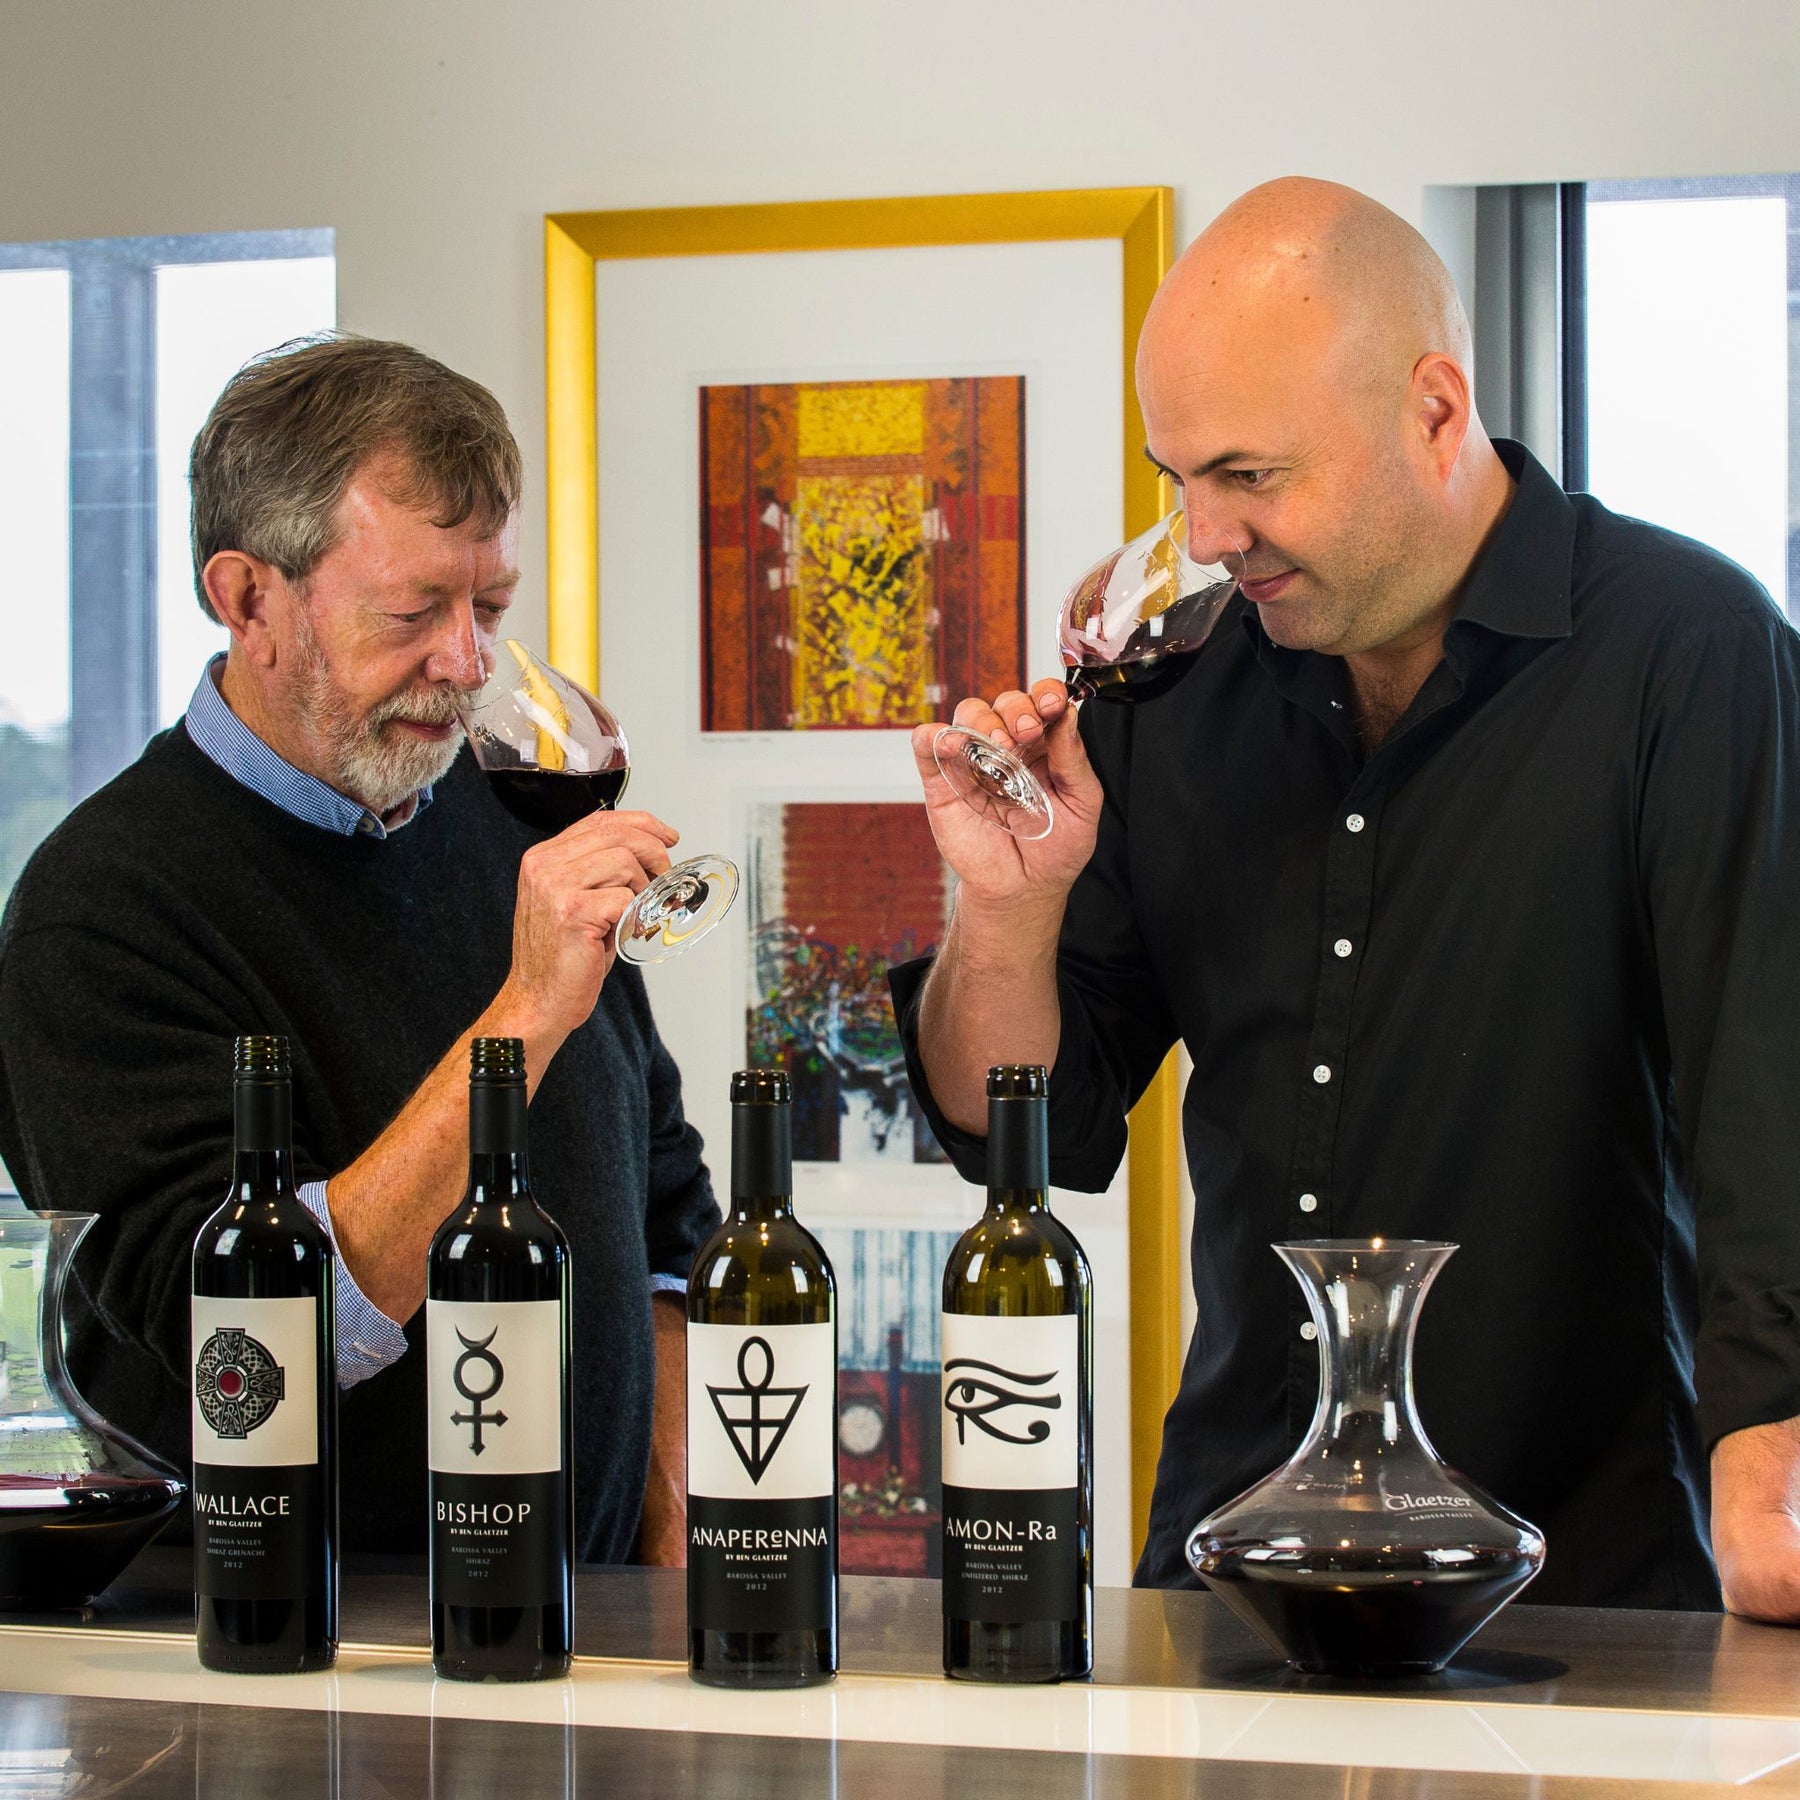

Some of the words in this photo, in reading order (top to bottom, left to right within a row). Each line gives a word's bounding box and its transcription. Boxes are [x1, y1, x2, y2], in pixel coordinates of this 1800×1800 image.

[195, 1492, 290, 1516] WALLACE
[1385, 1494, 1471, 1511] Glaetzer
[437, 1501, 531, 1524] BISHOP
[1409, 1514, 1444, 1522] BAROSSA
[215, 1519, 227, 1527] BEN
[228, 1520, 263, 1528] GLAETZER
[459, 1528, 472, 1536] BEN
[945, 1517, 1057, 1541] AMON-Ra
[208, 1537, 235, 1545] BAROSSA
[236, 1538, 262, 1546] VALLEY
[987, 1544, 1024, 1552] GLAETZER
[725, 1553, 734, 1561] BY
[223, 1561, 243, 1569] 2012
[965, 1562, 994, 1570] BAROSSA
[996, 1563, 1022, 1571] VALLEY
[761, 1572, 787, 1580] VALLEY
[745, 1583, 767, 1591] 2012
[982, 1586, 1003, 1594] 2012
